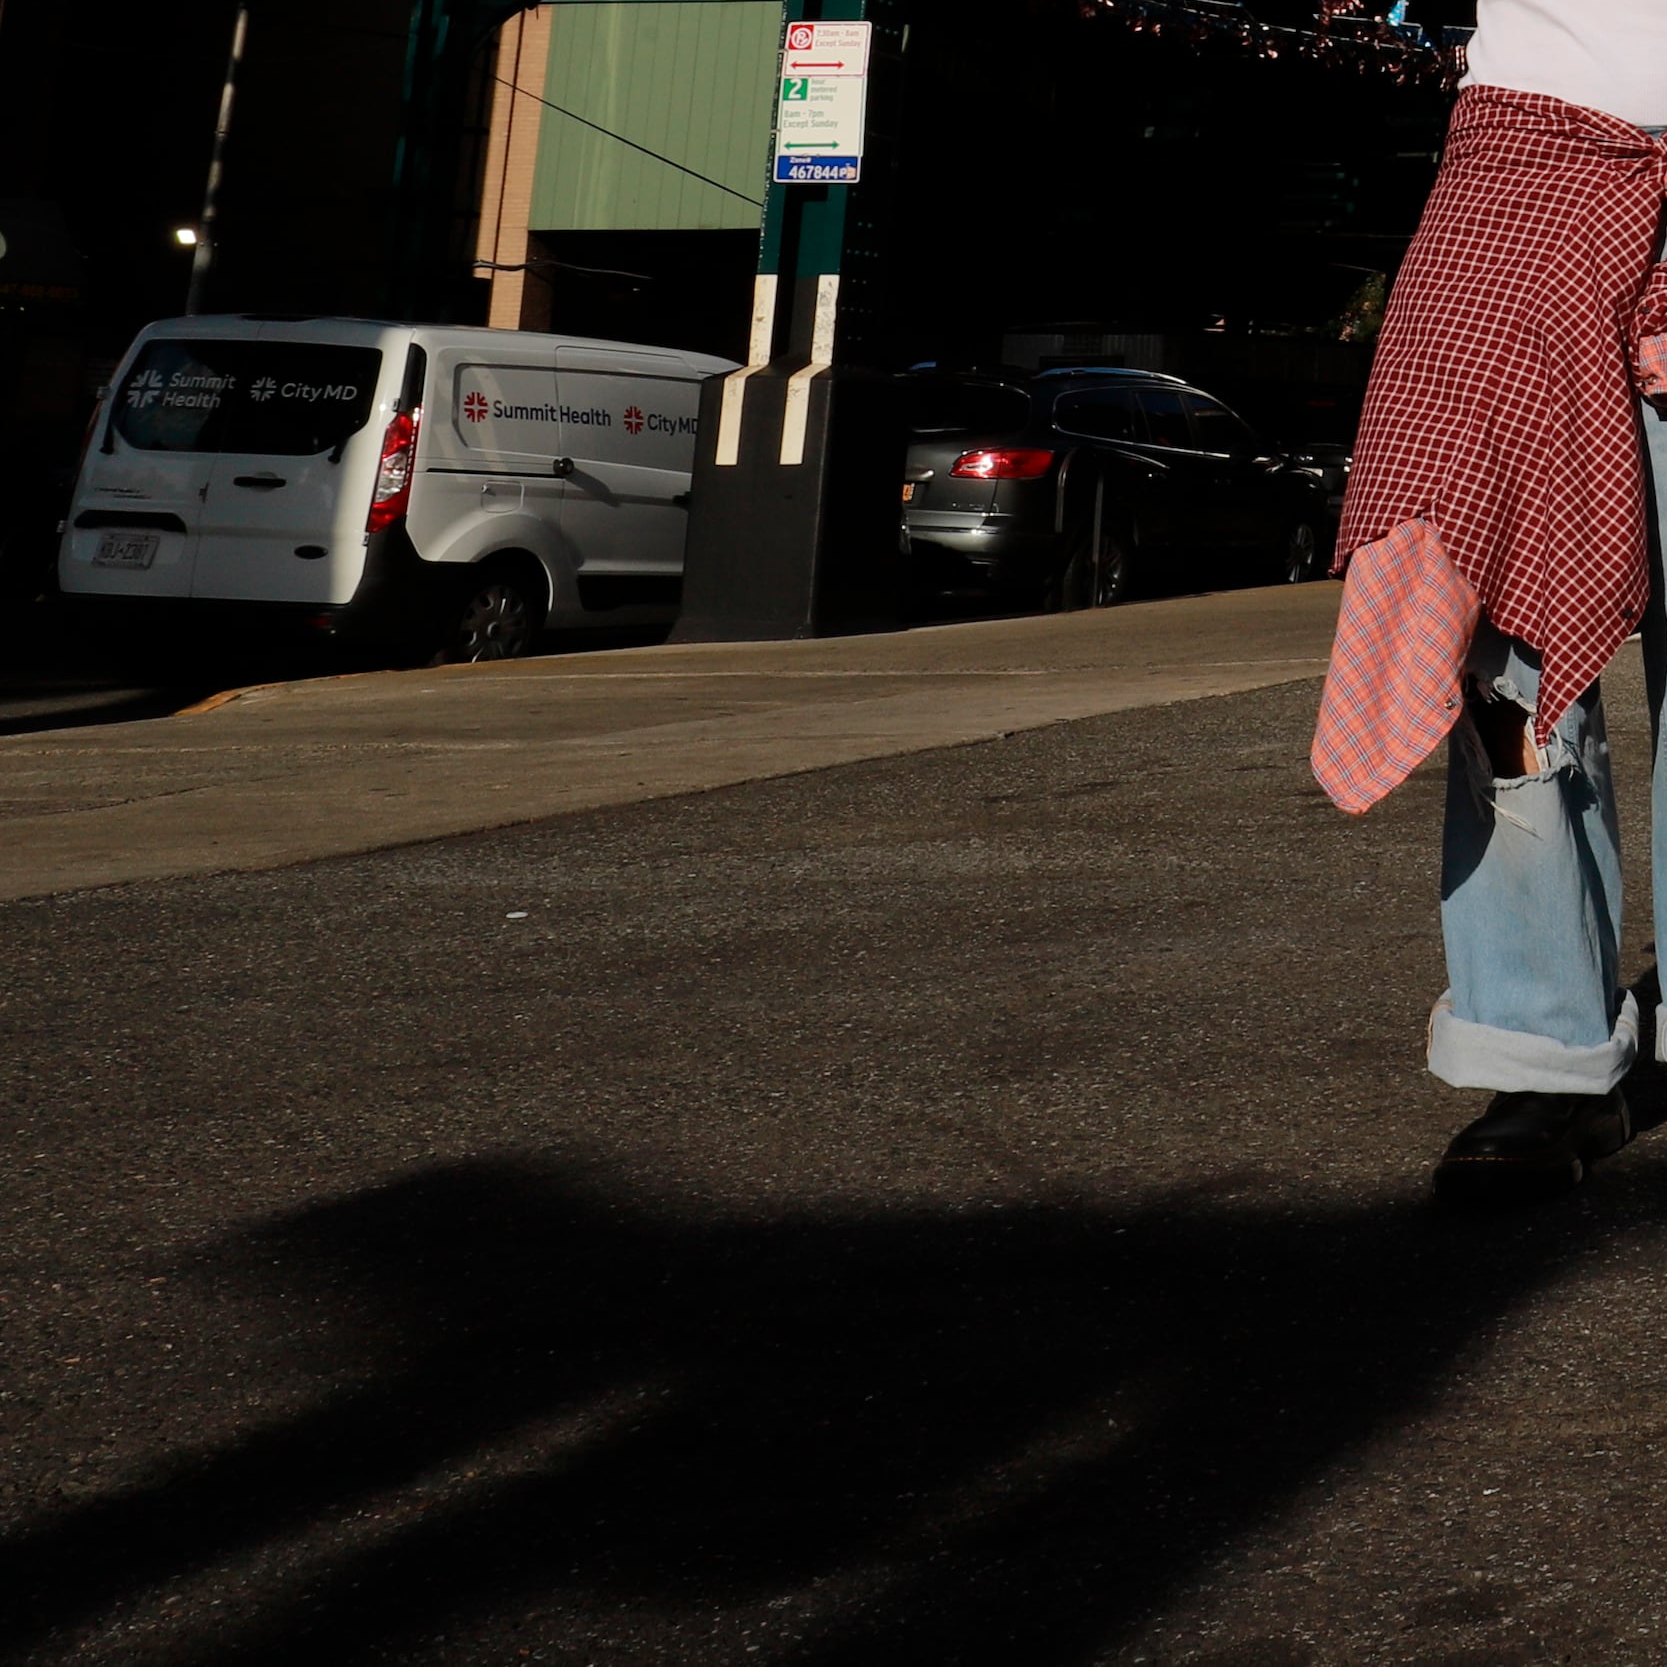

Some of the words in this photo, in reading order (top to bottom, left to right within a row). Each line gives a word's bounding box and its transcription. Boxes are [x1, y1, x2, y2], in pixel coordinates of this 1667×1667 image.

[815, 39, 837, 48] Except
[837, 39, 861, 49] Sunday
[787, 78, 803, 100] 2
[810, 94, 834, 102] parking
[808, 109, 825, 118] 7pm
[783, 119, 809, 129] Except
[811, 119, 839, 129] Sunday
[788, 165, 839, 180] 467844
[169, 372, 237, 390] Summit
[162, 392, 221, 409] Health
[493, 400, 558, 423] Summit
[559, 405, 612, 427] Health
